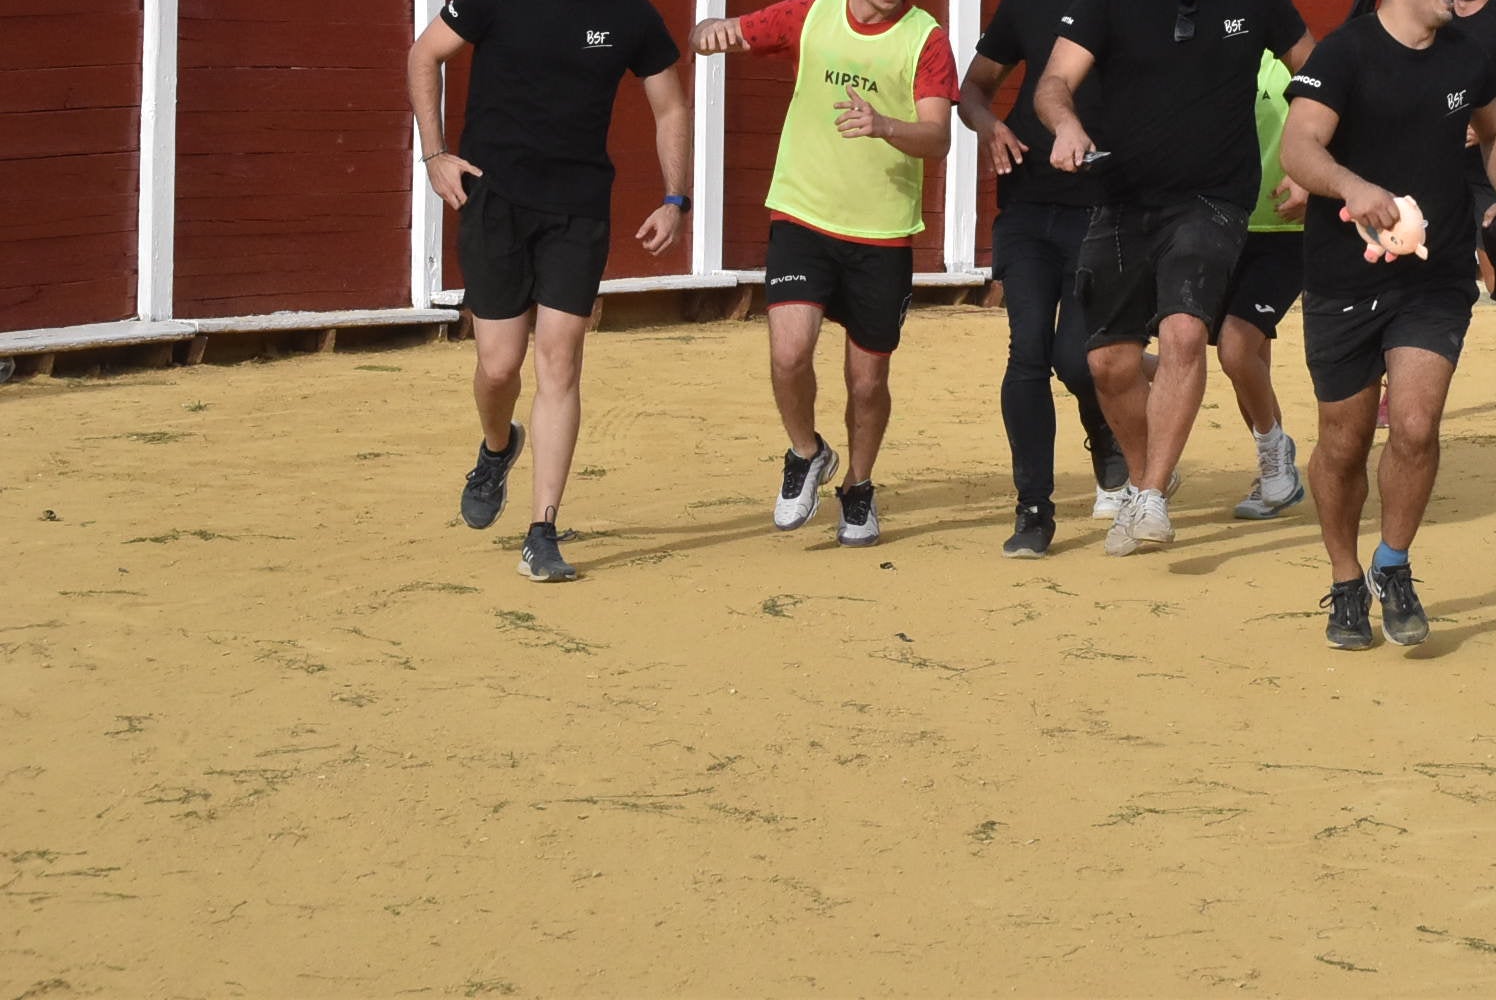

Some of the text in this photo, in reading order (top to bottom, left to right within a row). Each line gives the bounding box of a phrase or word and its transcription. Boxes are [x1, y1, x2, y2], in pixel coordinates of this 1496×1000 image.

[1224, 18, 1246, 33] BSF
[586, 30, 610, 45] BSF
[825, 69, 879, 93] KIPSTA
[1447, 89, 1467, 110] BSF
